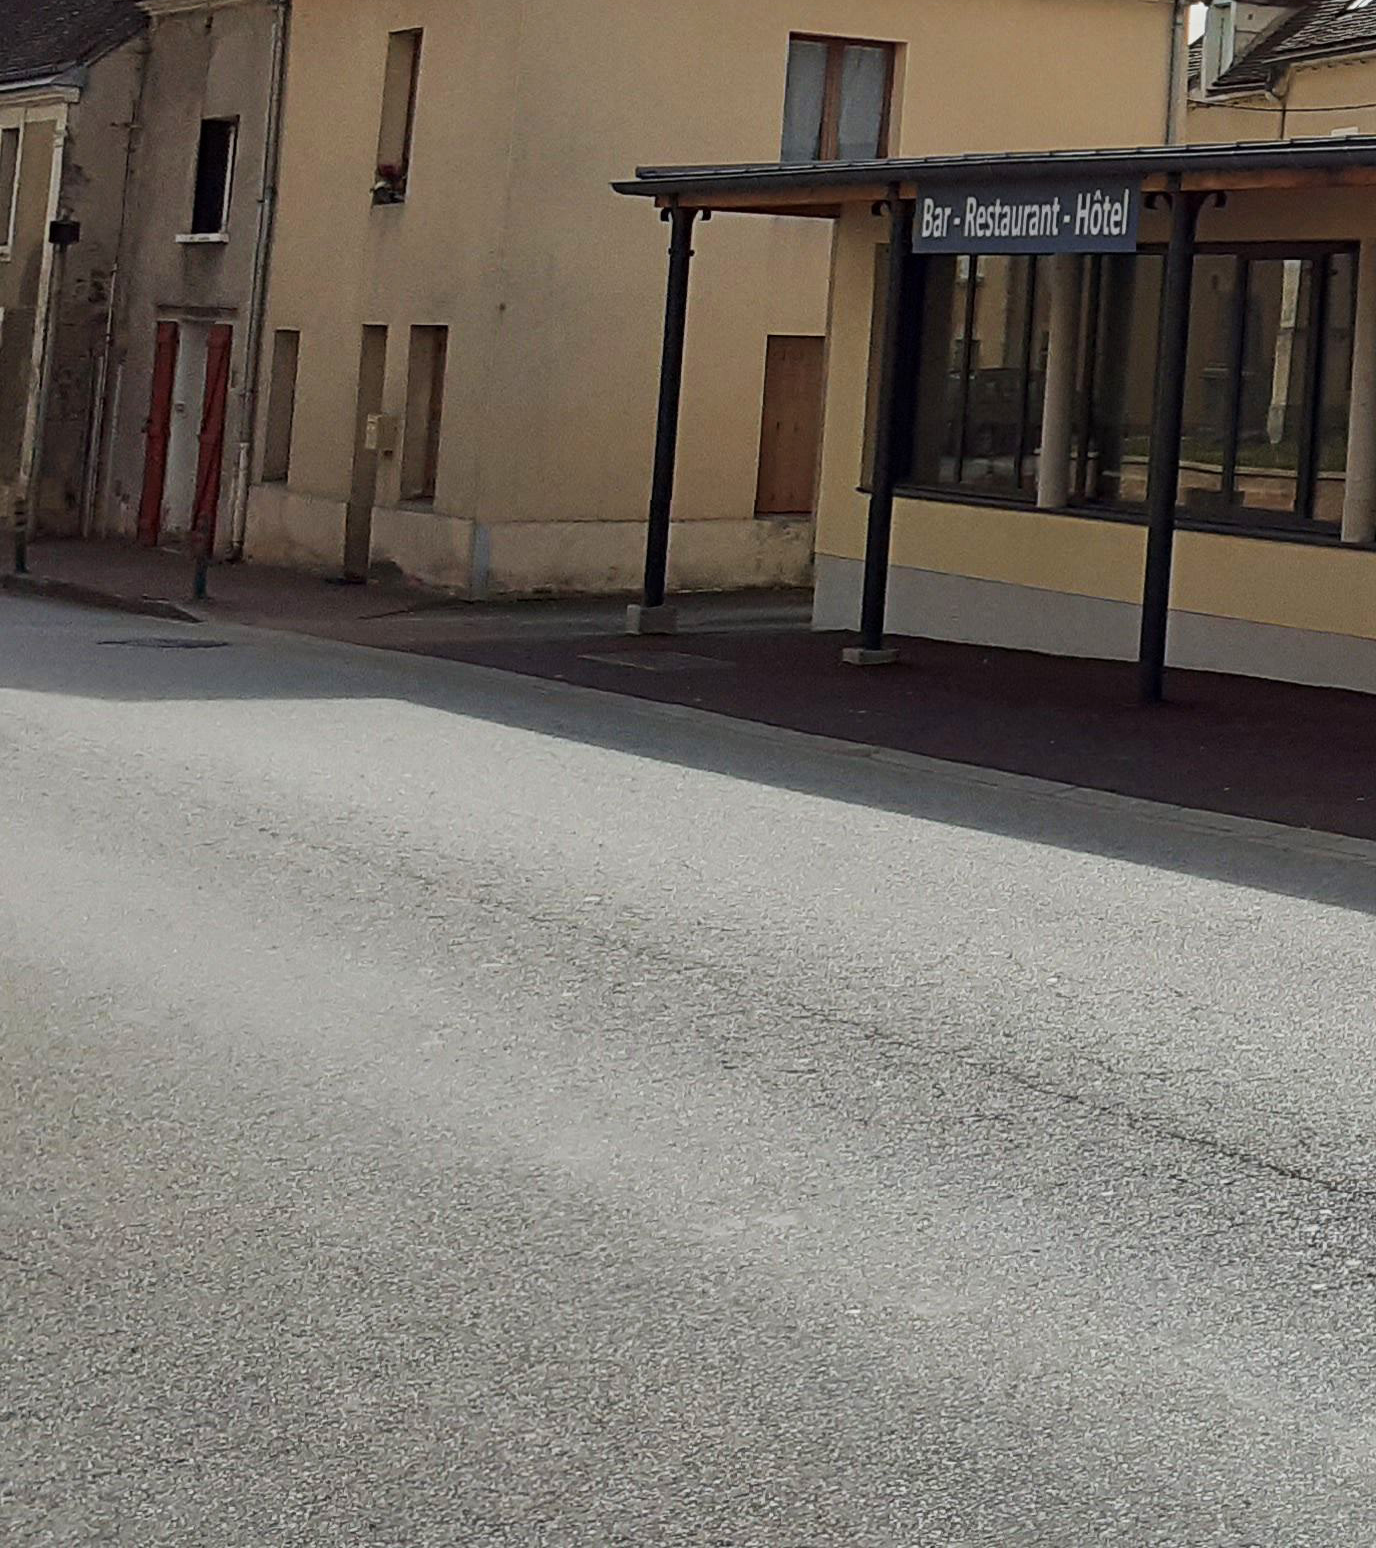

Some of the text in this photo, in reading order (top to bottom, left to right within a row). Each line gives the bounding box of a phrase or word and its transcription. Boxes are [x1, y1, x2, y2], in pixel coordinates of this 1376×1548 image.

[921, 198, 952, 237] Bar
[963, 197, 1060, 237] Restaurant
[1074, 189, 1130, 235] Hôtel
